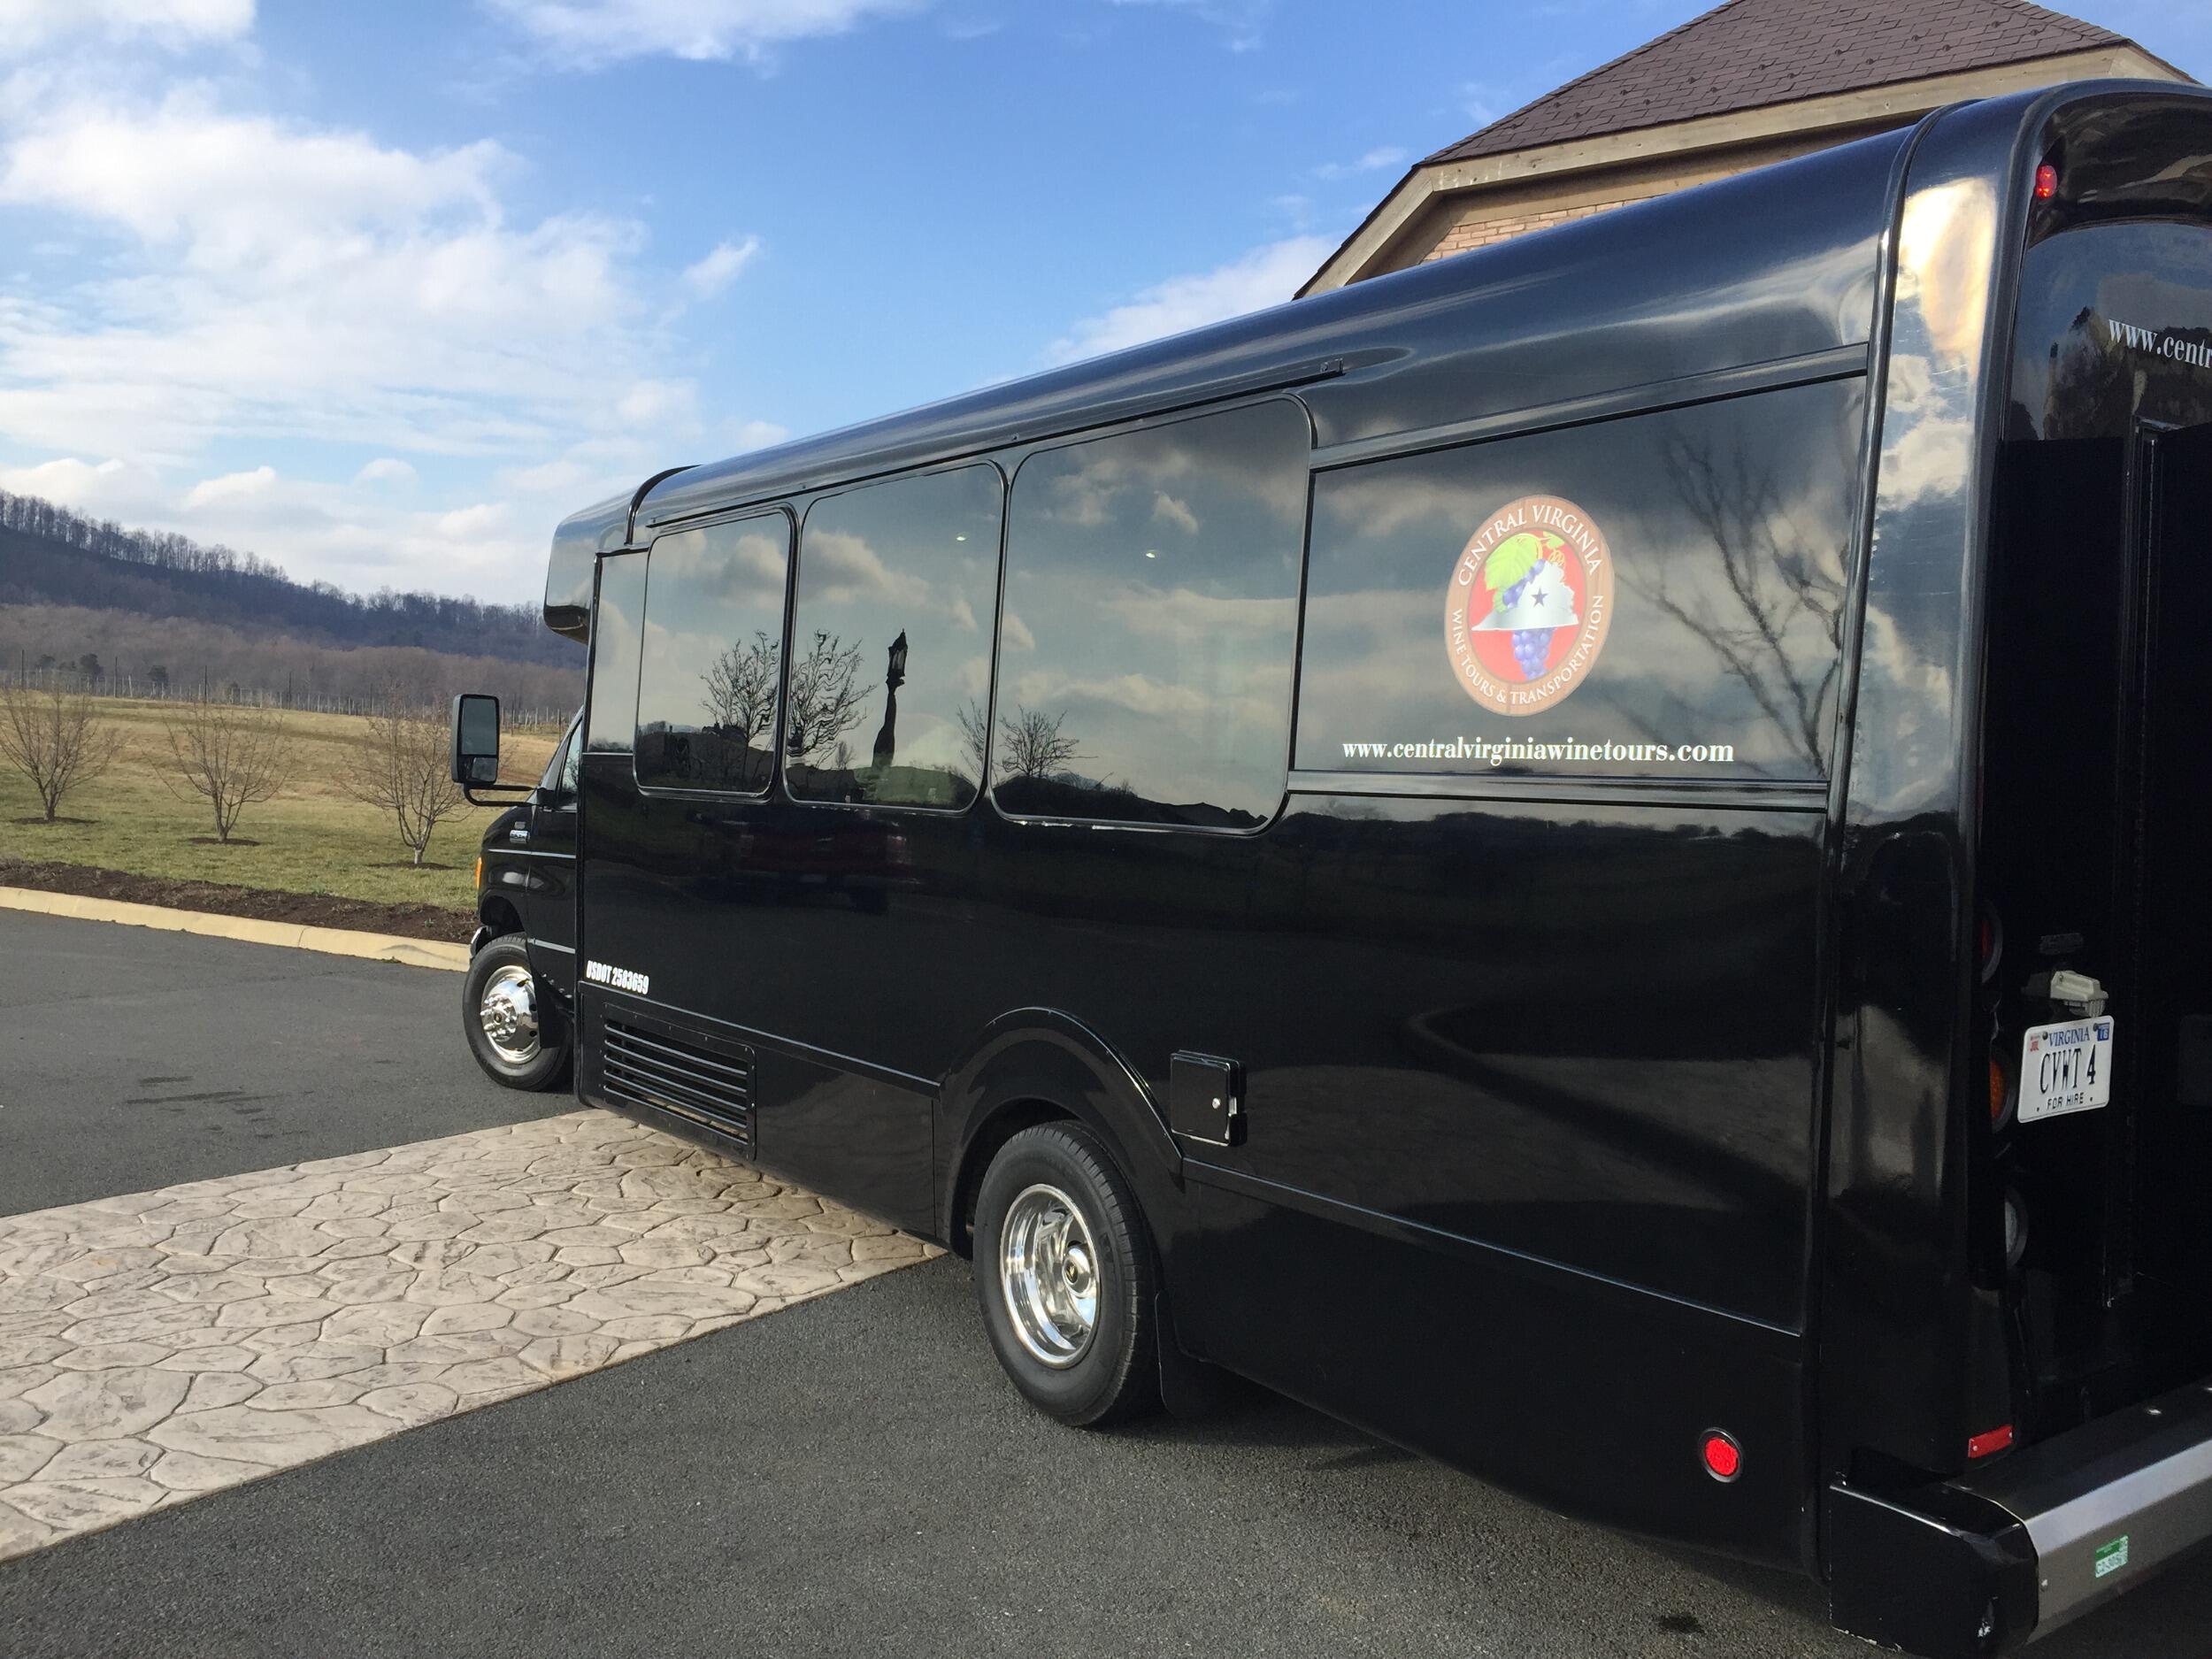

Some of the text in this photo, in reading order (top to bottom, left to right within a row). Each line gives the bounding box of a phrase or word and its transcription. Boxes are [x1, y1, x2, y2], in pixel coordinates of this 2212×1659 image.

[1458, 505, 1603, 586] CENTRAL VIRGINIA
[1452, 595, 1603, 705] WINE TOURS & TRANSPORTATION
[1342, 736, 1734, 767] www.centralvirginiawinetours.com
[586, 960, 612, 983] USDOT
[2048, 1027, 2090, 1047] VIRGINIA
[2086, 1044, 2096, 1085] 4
[2047, 1092, 2085, 1110] FOR HIRE
